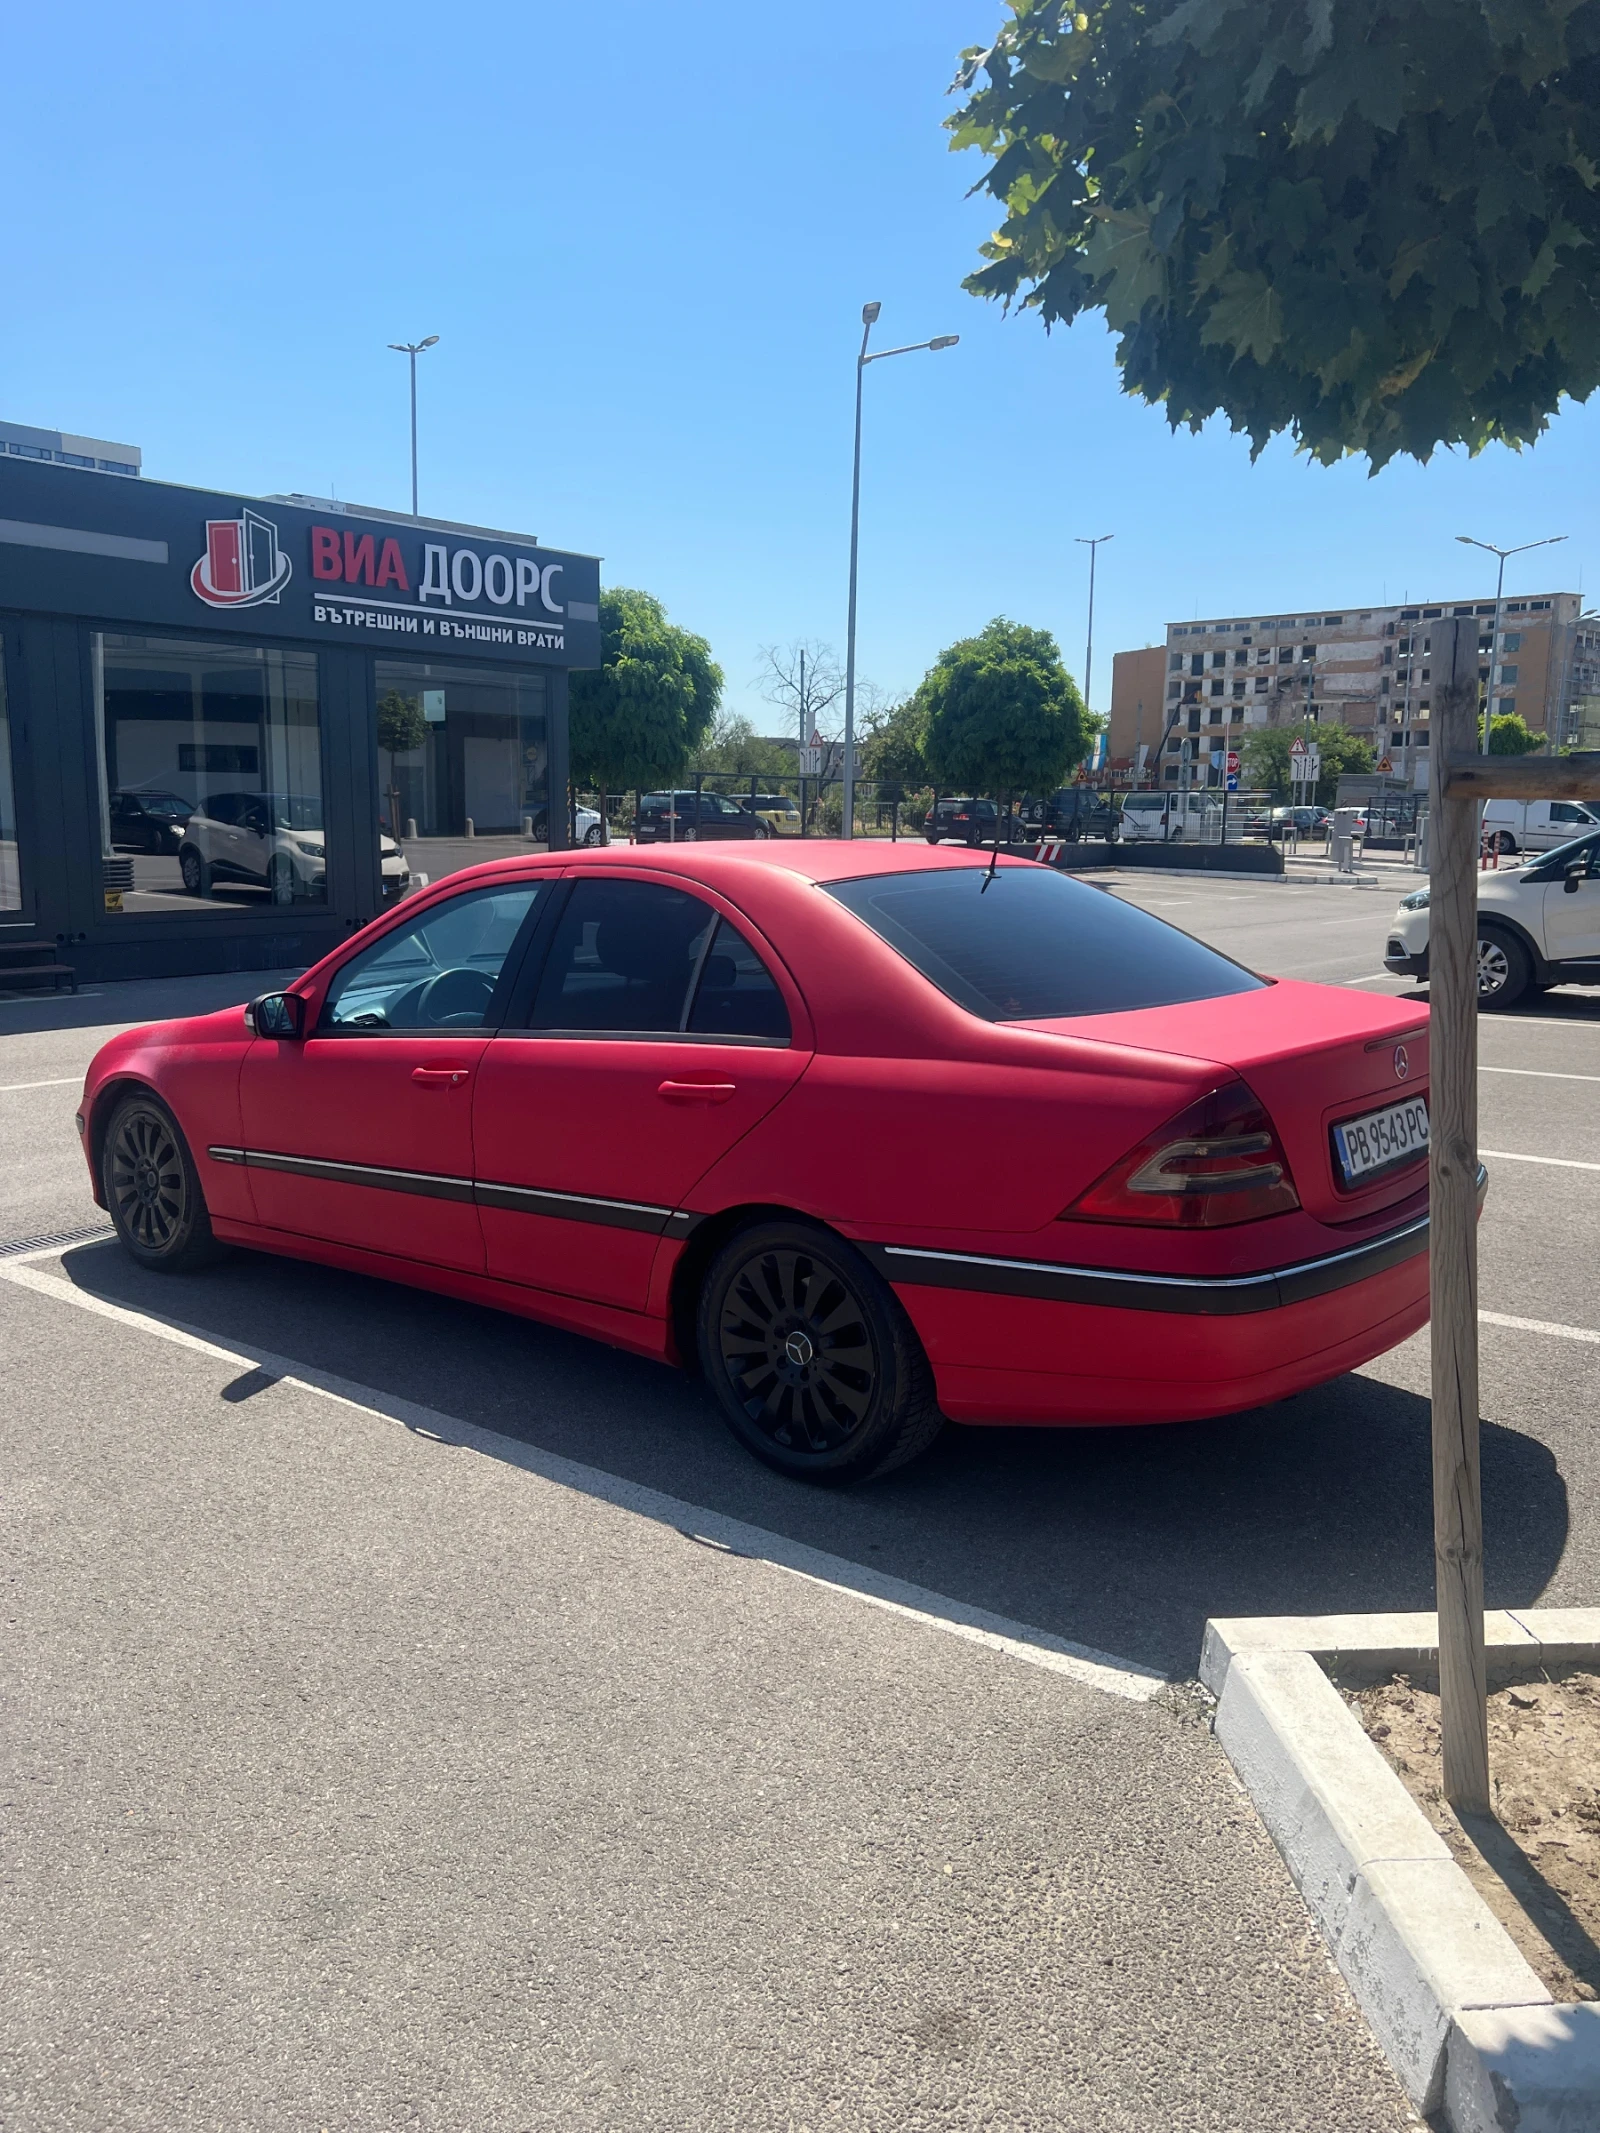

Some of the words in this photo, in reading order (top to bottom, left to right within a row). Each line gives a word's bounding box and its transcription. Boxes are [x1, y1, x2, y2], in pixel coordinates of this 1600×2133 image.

[312, 525, 409, 591] ВИА
[419, 543, 564, 613] ДООРС
[314, 605, 418, 633] ВЪТРЕШНИ
[423, 618, 435, 635] И
[440, 621, 513, 644] ВЪНШНИ
[517, 631, 565, 650] ВРАТИ
